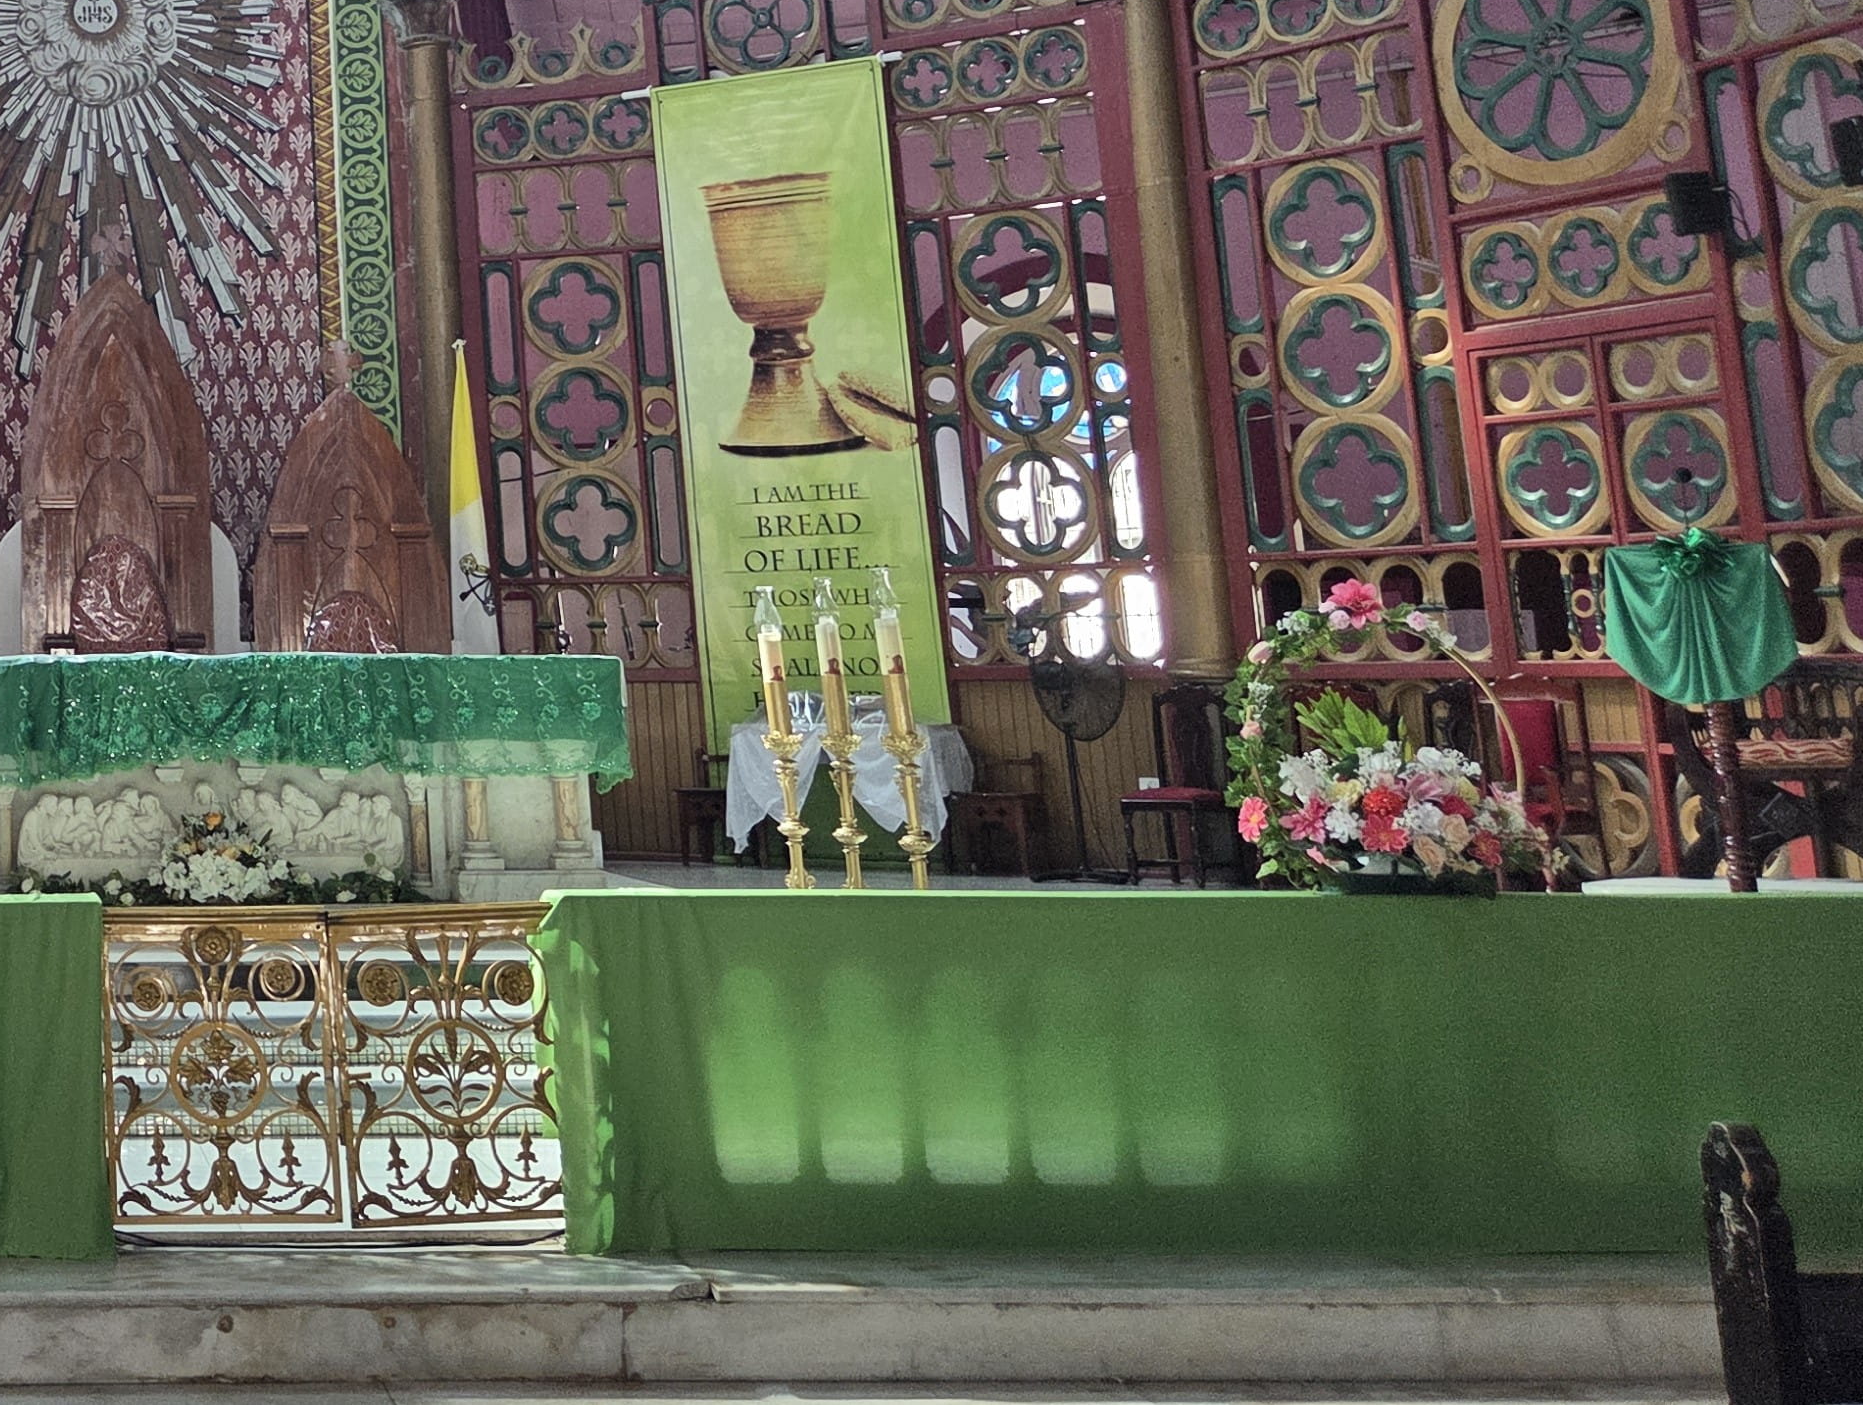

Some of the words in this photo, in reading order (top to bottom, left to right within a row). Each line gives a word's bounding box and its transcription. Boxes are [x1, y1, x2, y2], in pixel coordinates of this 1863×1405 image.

[753, 487, 761, 504] I
[768, 485, 804, 503] AM
[809, 482, 861, 500] THE
[756, 512, 861, 538] BREAD
[744, 549, 785, 573] OF
[795, 547, 889, 573] LIFE...
[745, 622, 815, 643] CME
[843, 656, 879, 677] NO
